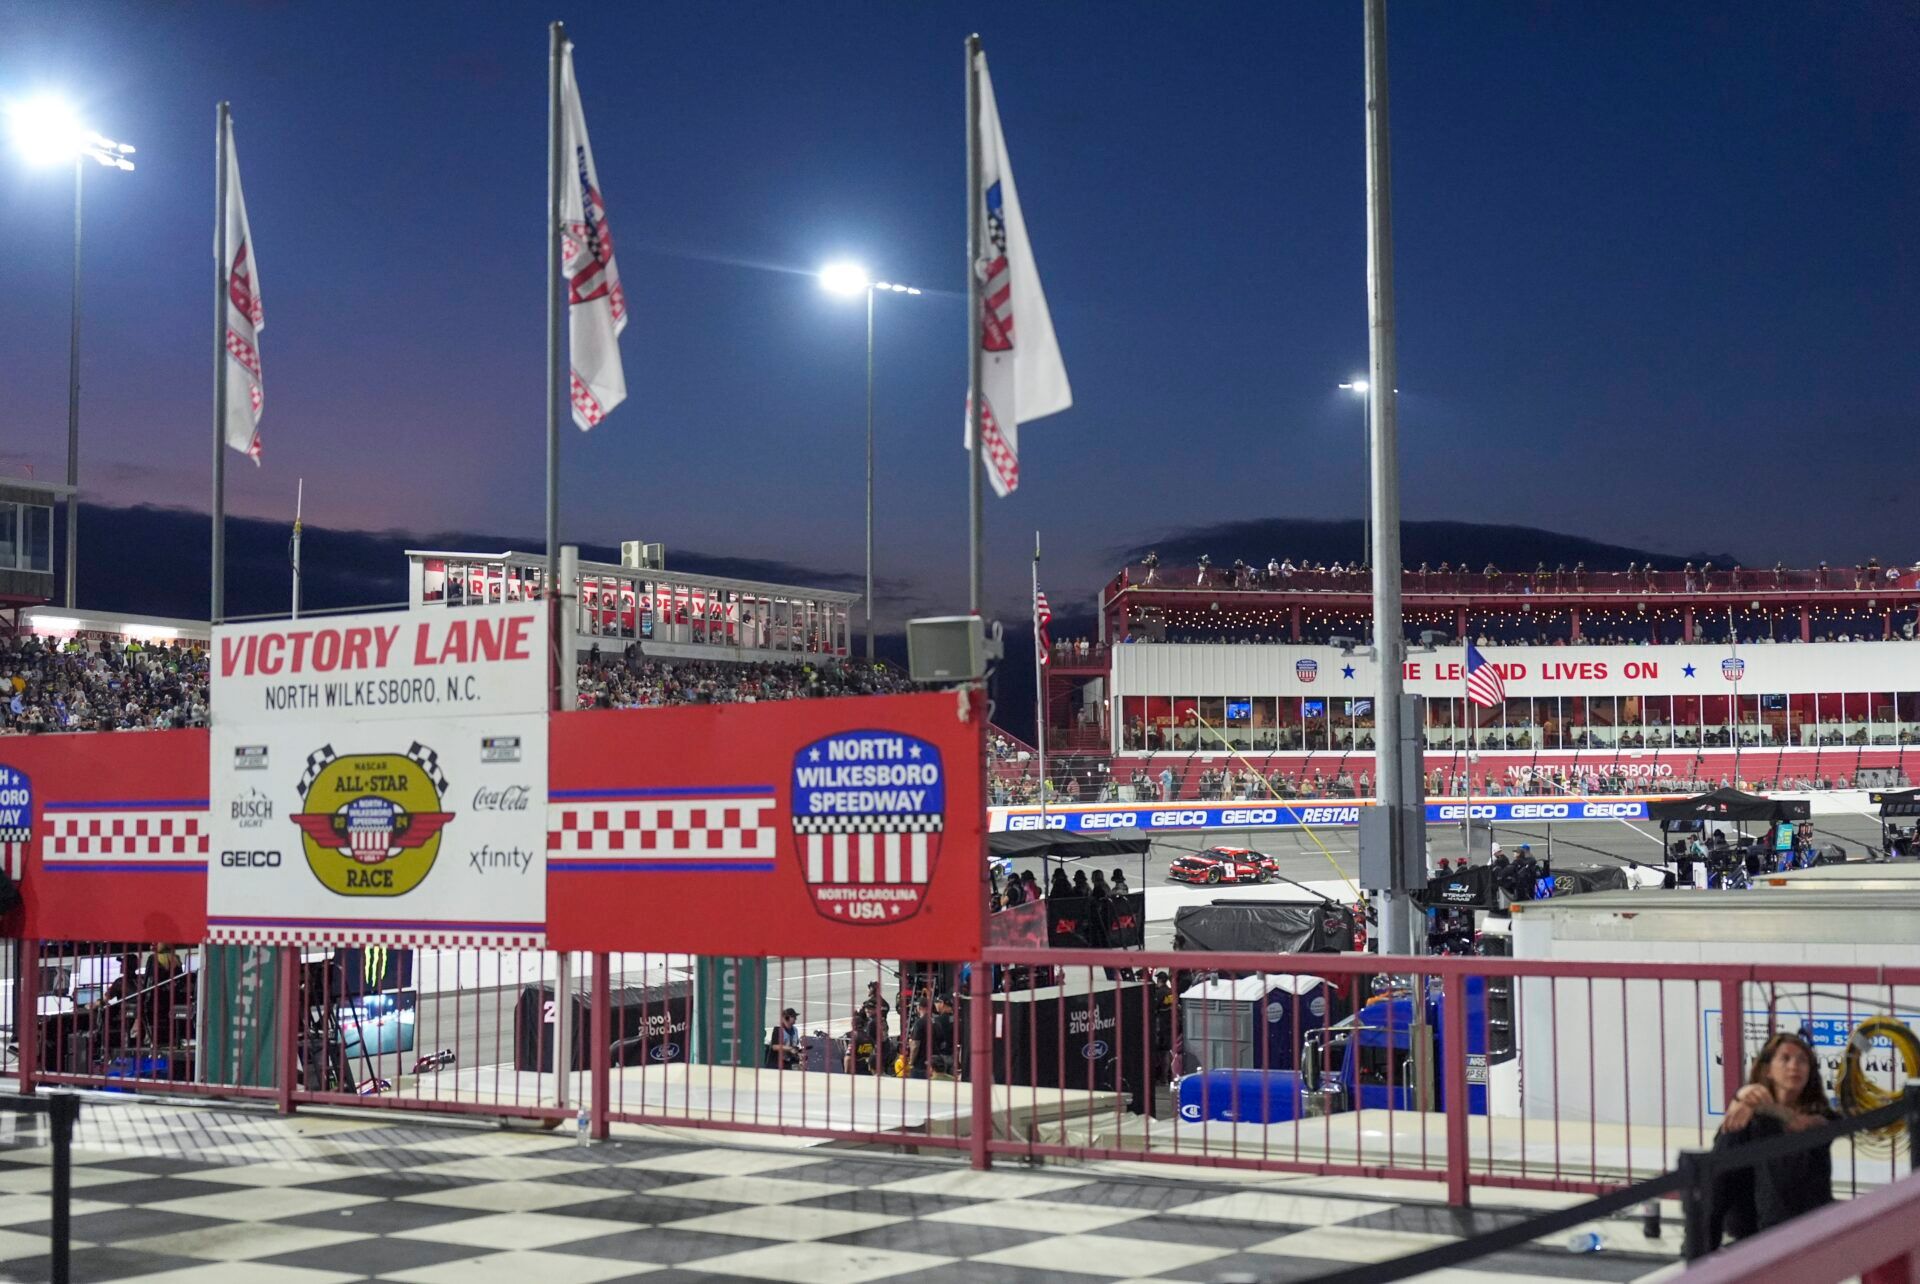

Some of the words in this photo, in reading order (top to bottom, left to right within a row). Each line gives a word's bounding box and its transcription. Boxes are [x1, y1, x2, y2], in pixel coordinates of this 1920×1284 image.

[221, 625, 400, 677] VICTORY
[413, 616, 535, 666] LANE
[1435, 663, 1527, 681] LEND
[1542, 663, 1608, 680] LIVES
[1623, 662, 1659, 679] ON
[265, 683, 319, 711] NORTH
[325, 677, 441, 705] WILKESBORO,
[446, 675, 481, 701] N.C.
[828, 738, 904, 761] NORTH
[354, 761, 388, 771] NASCAR
[1570, 763, 1673, 778] WILKESBORO
[796, 763, 939, 788] WILKESBORO
[231, 801, 273, 819] BUSCH
[809, 790, 926, 813] SPEEDWAY
[1009, 814, 1066, 832] GEICO
[1080, 812, 1137, 829] GEICO
[1150, 811, 1207, 827] GEICO
[1221, 809, 1277, 824] GEICO
[1301, 807, 1359, 823] RESTAR
[1439, 805, 1497, 819] GEICO
[1510, 803, 1569, 818] GEICO
[1582, 803, 1642, 817] GEICO
[239, 819, 263, 829] LIGHT
[220, 851, 282, 867] GEICO
[469, 844, 534, 875] xfinity
[346, 869, 394, 888] RACE
[1224, 863, 1236, 878] 8
[817, 889, 857, 901] NORTH
[858, 888, 918, 901] CAROLINA
[848, 902, 886, 919] USA
